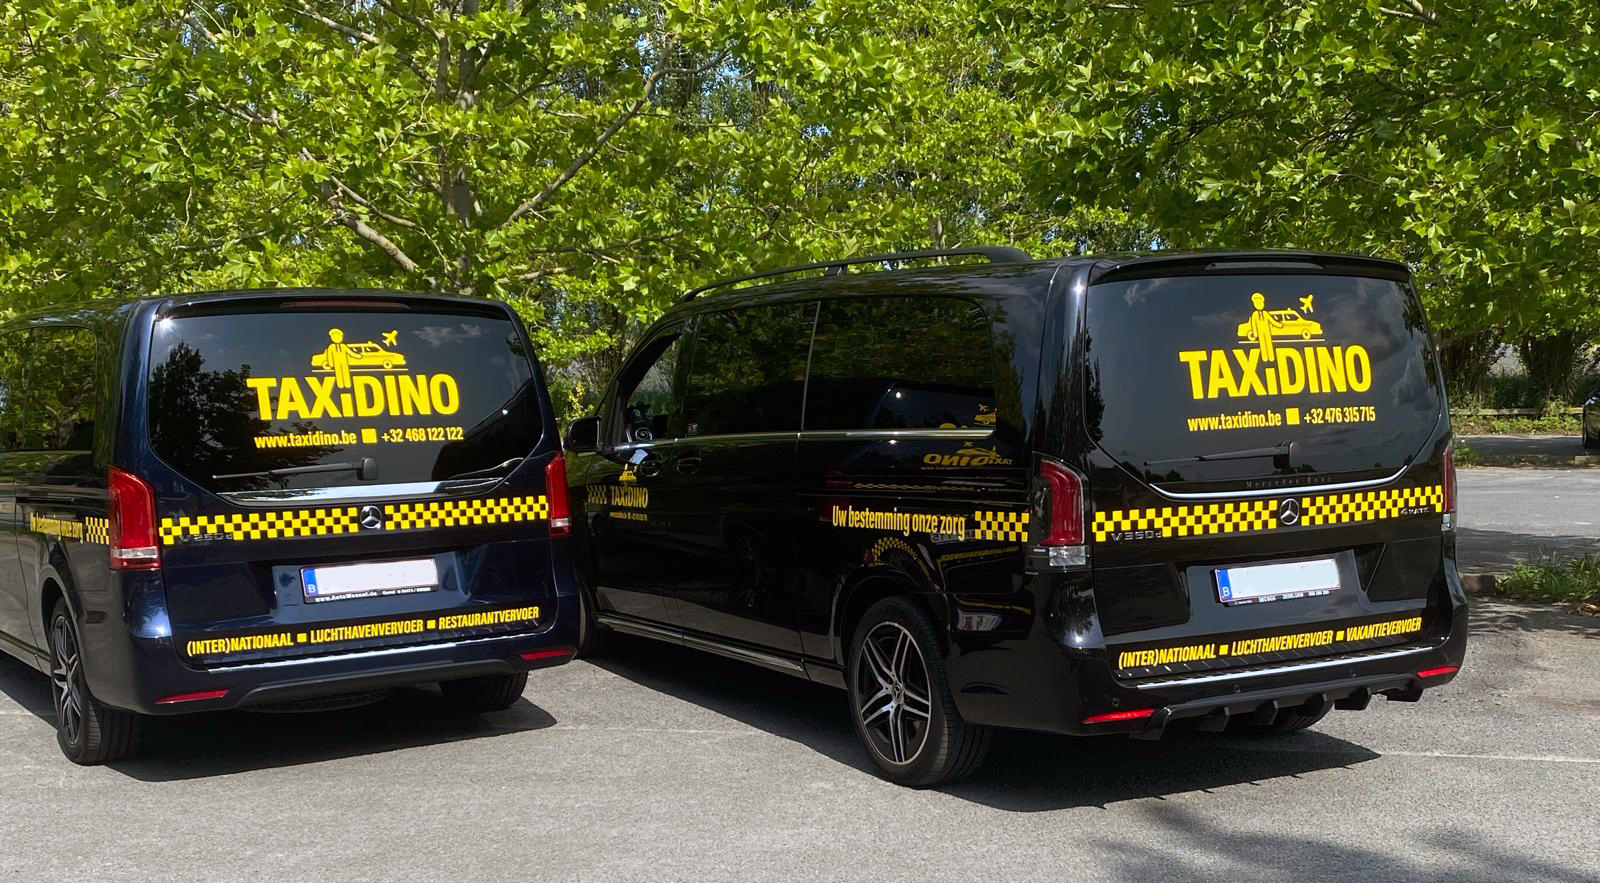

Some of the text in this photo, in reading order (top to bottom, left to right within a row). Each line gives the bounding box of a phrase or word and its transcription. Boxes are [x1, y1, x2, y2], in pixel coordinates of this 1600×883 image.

[1187, 406, 1376, 432] www.taxidino.be +32 476 315 715
[253, 426, 464, 449] www.taxidino.be +32 468 122 122
[831, 504, 966, 541] Uw bestemming onze zorg
[307, 583, 316, 594] B
[1222, 586, 1231, 597] B
[186, 606, 540, 657] (INTER)NATIONAAL LUCHTHAVENVERVOER RESTAURANTVERVOER
[1118, 617, 1422, 670] (INTER)NATIONAAL LUCHTHAVENVERVOER VAKANTIEVERVOER
